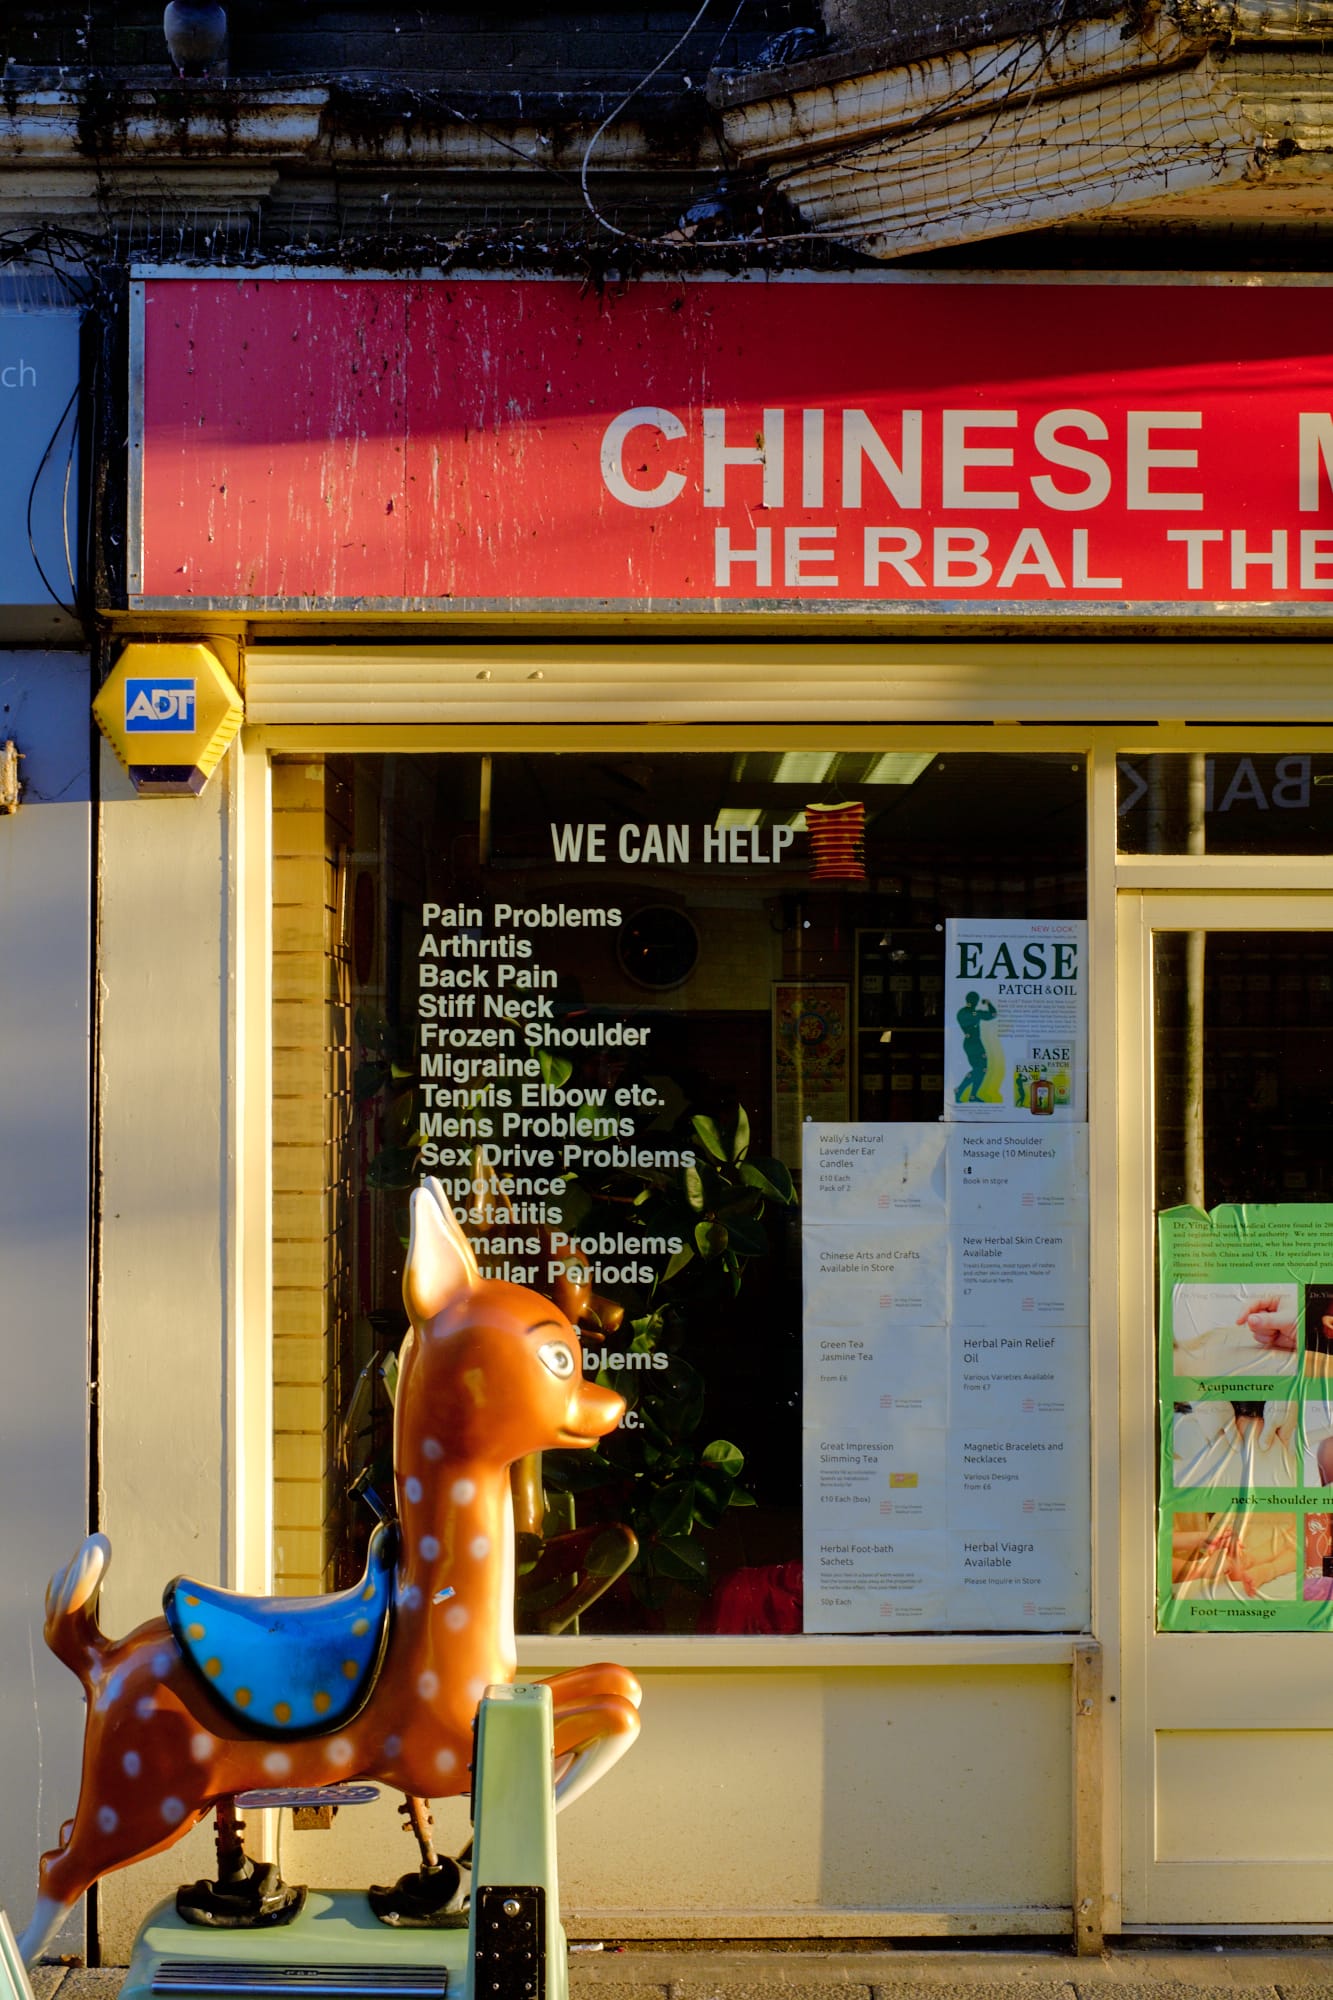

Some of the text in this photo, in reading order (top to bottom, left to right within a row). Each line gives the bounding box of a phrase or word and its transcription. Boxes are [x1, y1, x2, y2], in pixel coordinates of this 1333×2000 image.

[1, 359, 37, 388] ch
[599, 406, 1204, 512] CHINESE
[714, 527, 1333, 590] HERBAL THE
[126, 689, 195, 721] ADT
[551, 823, 794, 865] WE CAN HELP
[422, 904, 623, 928] Pain Problems
[418, 934, 532, 958] Arthritis
[956, 942, 1078, 980] EASE
[419, 964, 558, 988] Back Pain
[418, 994, 554, 1018] Stiff Neck
[421, 1023, 651, 1047] Frozen Shoulder
[1032, 1048, 1070, 1061] EASE
[421, 1053, 541, 1083] Migraine
[1016, 1064, 1040, 1073] EASE
[420, 1084, 665, 1107] Tennis Elbow etc.
[419, 1113, 635, 1137] Mens Problems
[852, 1134, 884, 1143] Natural
[963, 1136, 1043, 1145] Neck and Shoulder
[420, 1143, 696, 1168] Sex Drive Problems
[819, 1147, 875, 1155] Lavender Ear
[963, 1150, 1000, 1159] Massage
[1018, 1149, 1056, 1158] Minutes)
[819, 1159, 854, 1168] Candles
[837, 1184, 845, 1192] of
[452, 1201, 563, 1225] ostatitis
[550, 1232, 683, 1255] Problems
[963, 1236, 1063, 1245] New Herbal Skin Cream
[820, 1250, 920, 1260] Chinese Arts and Crafts
[963, 1249, 1003, 1257] Available
[547, 1261, 655, 1284] Periods
[820, 1264, 895, 1273] Available in Store
[820, 1340, 864, 1349] Green Tea
[964, 1338, 1055, 1348] Herbal Pain Relief
[582, 1348, 669, 1371] blems
[820, 1353, 873, 1361] Jasmine Tea
[963, 1353, 979, 1363] Oil
[1023, 1373, 1055, 1381] Available
[1197, 1382, 1275, 1394] Acupuncture
[820, 1442, 894, 1452] Great Impression
[964, 1442, 1063, 1452] Magnetic Bracelets and
[820, 1455, 878, 1465] Slimming Tea
[964, 1455, 1007, 1463] Necklaces
[963, 1473, 1019, 1482] Various Designs
[835, 1495, 851, 1503] Each
[820, 1544, 894, 1553] Herbal Foot-bath
[964, 1542, 1034, 1553] Herbal Viagra
[820, 1557, 854, 1566] Sachets
[964, 1558, 1012, 1567] Available
[988, 1578, 1013, 1586] Inquire
[1022, 1577, 1042, 1585] Store
[835, 1598, 852, 1606] Each
[1191, 1606, 1277, 1619] Foot-massage
